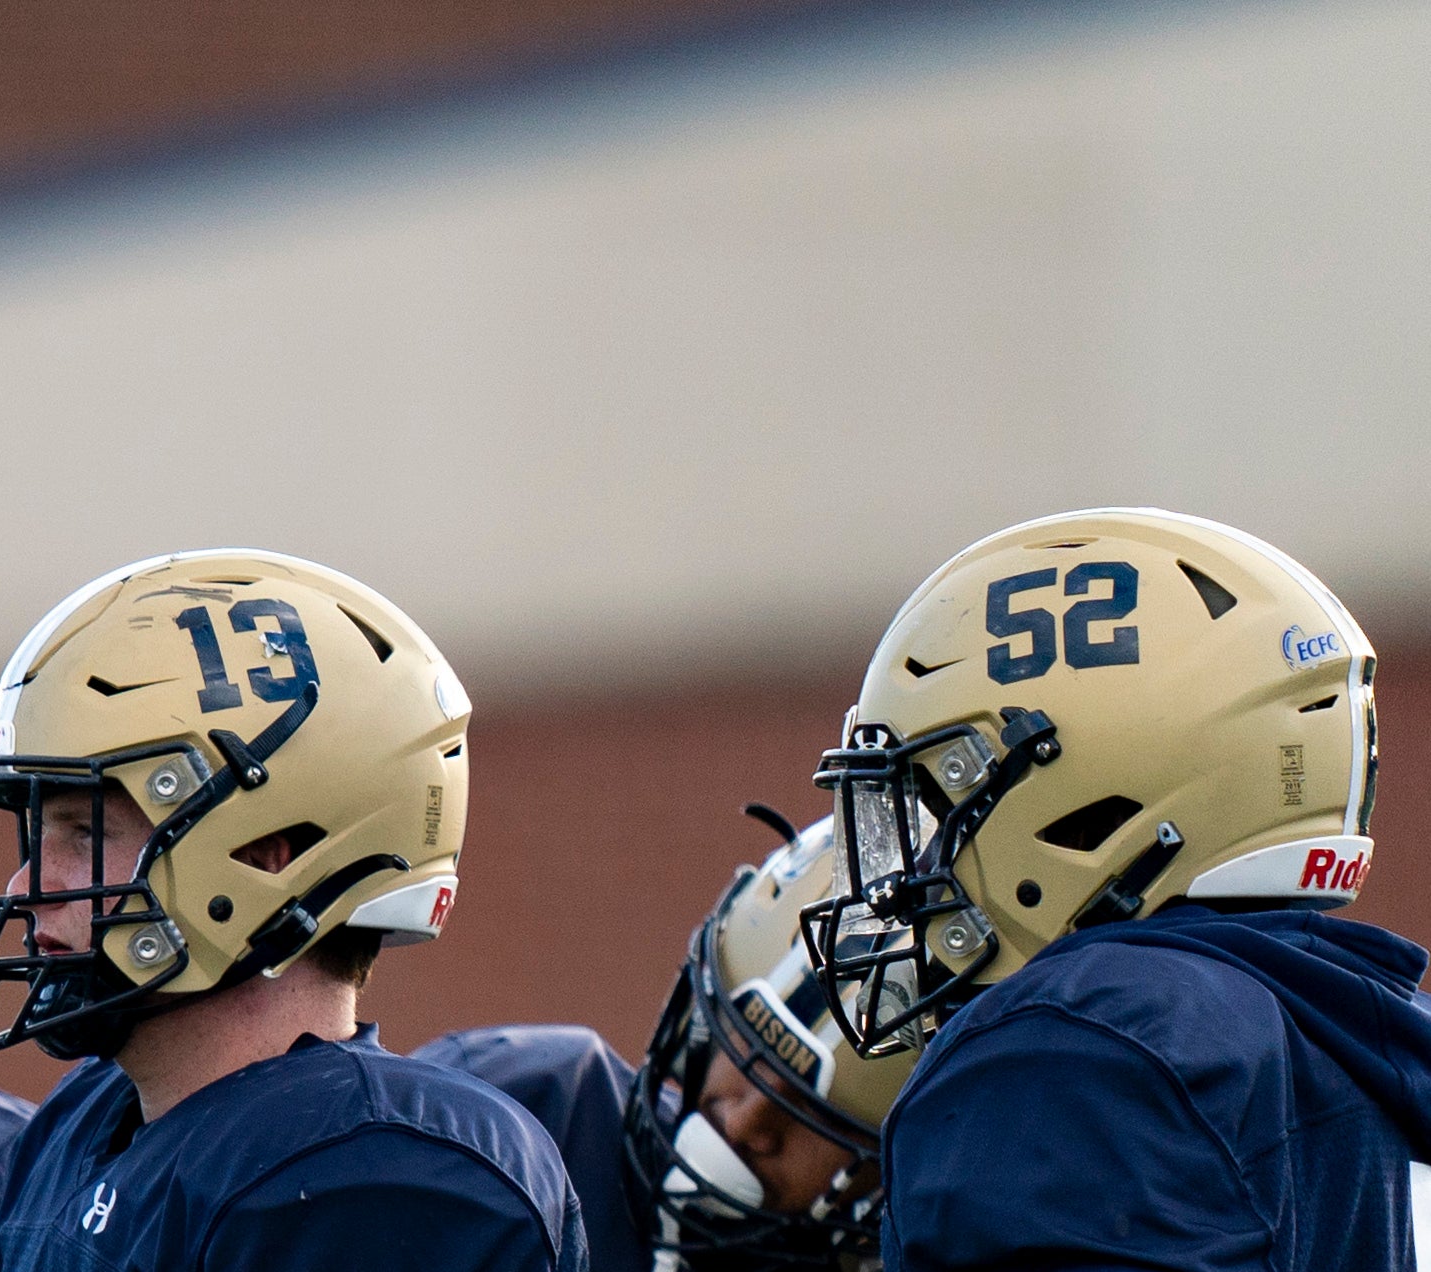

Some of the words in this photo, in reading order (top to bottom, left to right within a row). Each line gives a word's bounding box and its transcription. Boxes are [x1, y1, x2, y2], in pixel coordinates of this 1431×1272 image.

[174, 598, 320, 714] 13
[986, 561, 1139, 686] 52
[1296, 633, 1339, 661] ECFC
[744, 994, 817, 1075] BISON
